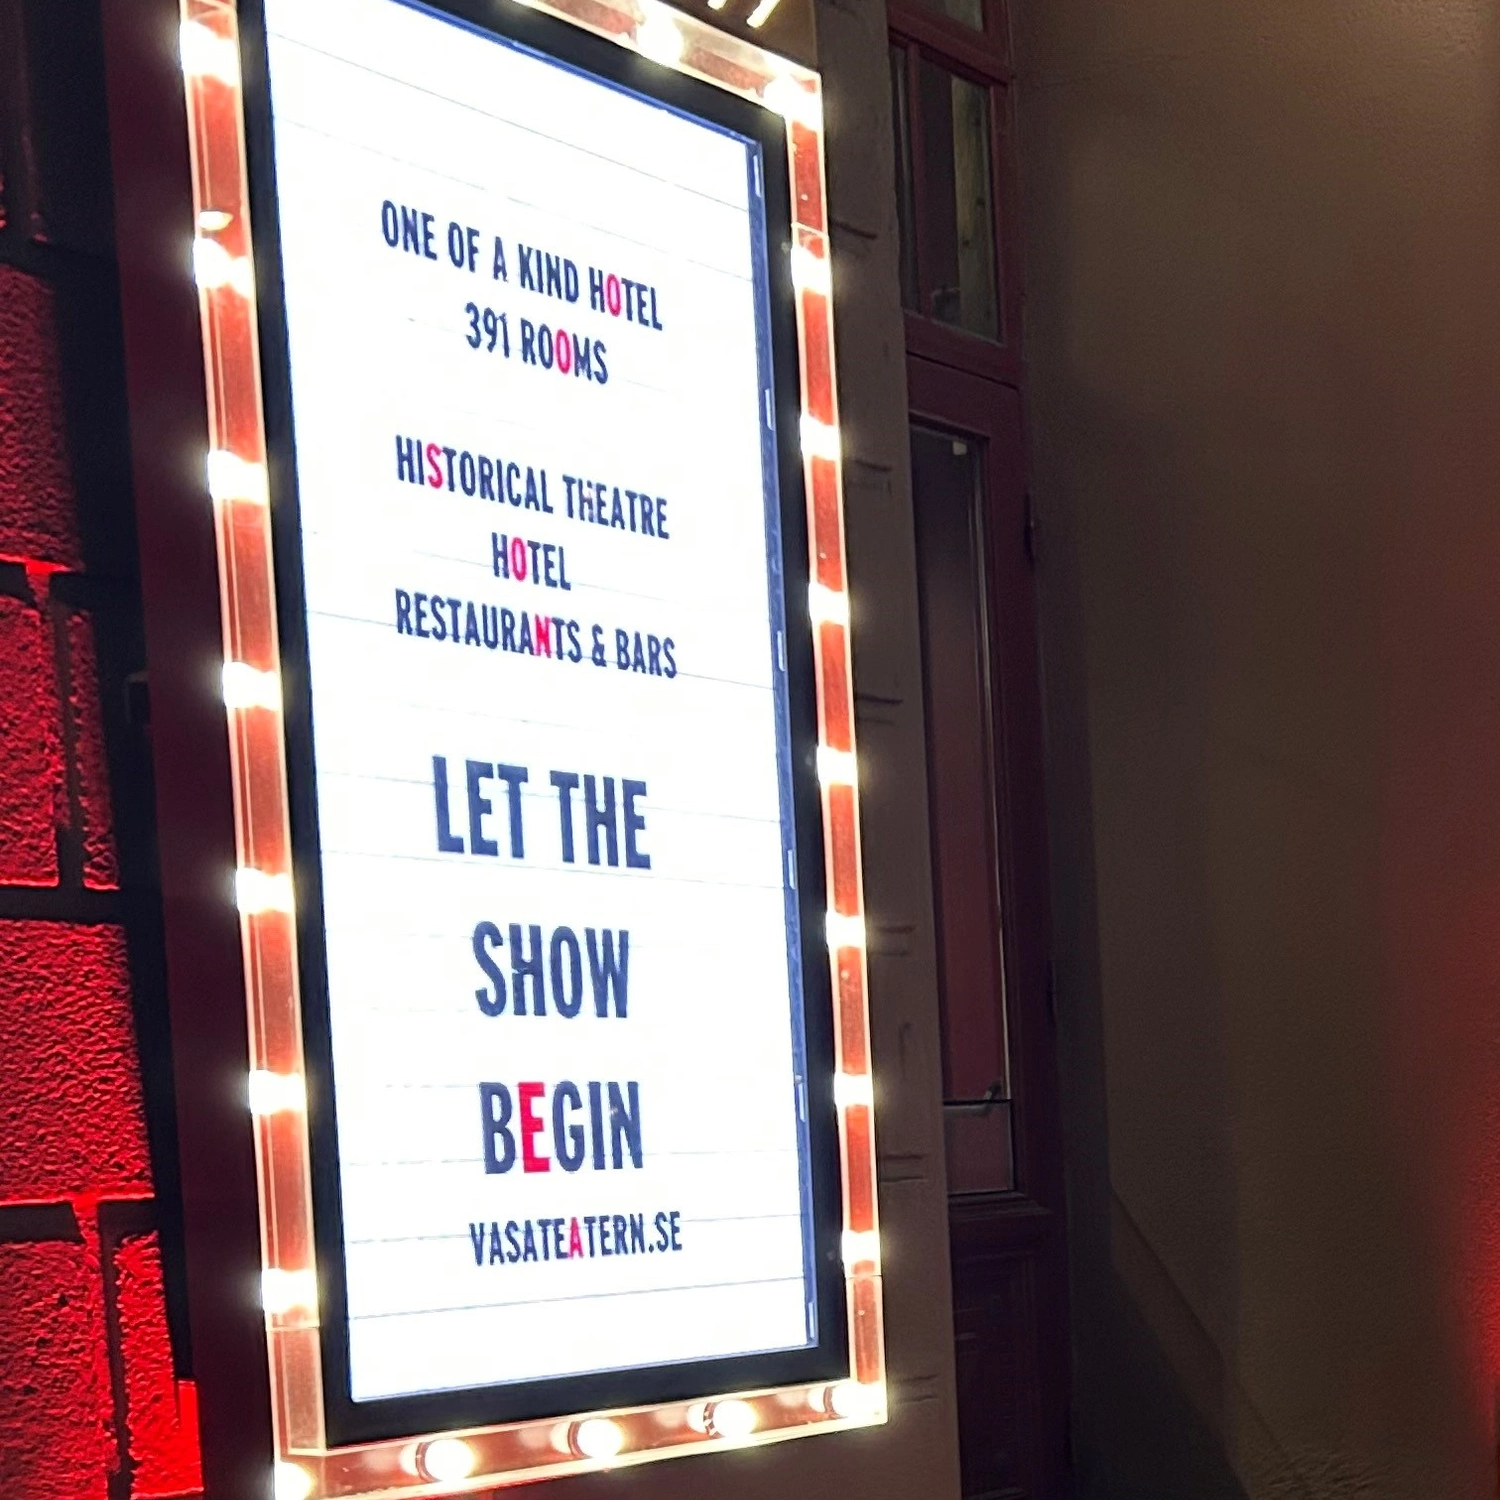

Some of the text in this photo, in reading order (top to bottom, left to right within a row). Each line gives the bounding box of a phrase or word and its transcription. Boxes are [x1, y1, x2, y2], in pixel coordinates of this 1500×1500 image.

[382, 200, 663, 332] ONE OF A KIND HOTEL
[465, 303, 609, 385] 391 ROOMS
[396, 435, 670, 539] HISTORICAL THEATRE
[492, 532, 571, 591] HOTEL
[395, 589, 678, 679] RESTAURANTS & BARS
[432, 755, 651, 870] LET THE
[472, 920, 630, 1020] SHOW
[479, 1080, 644, 1175] BEGIN
[469, 1210, 683, 1266] VASATEATERN.SE
